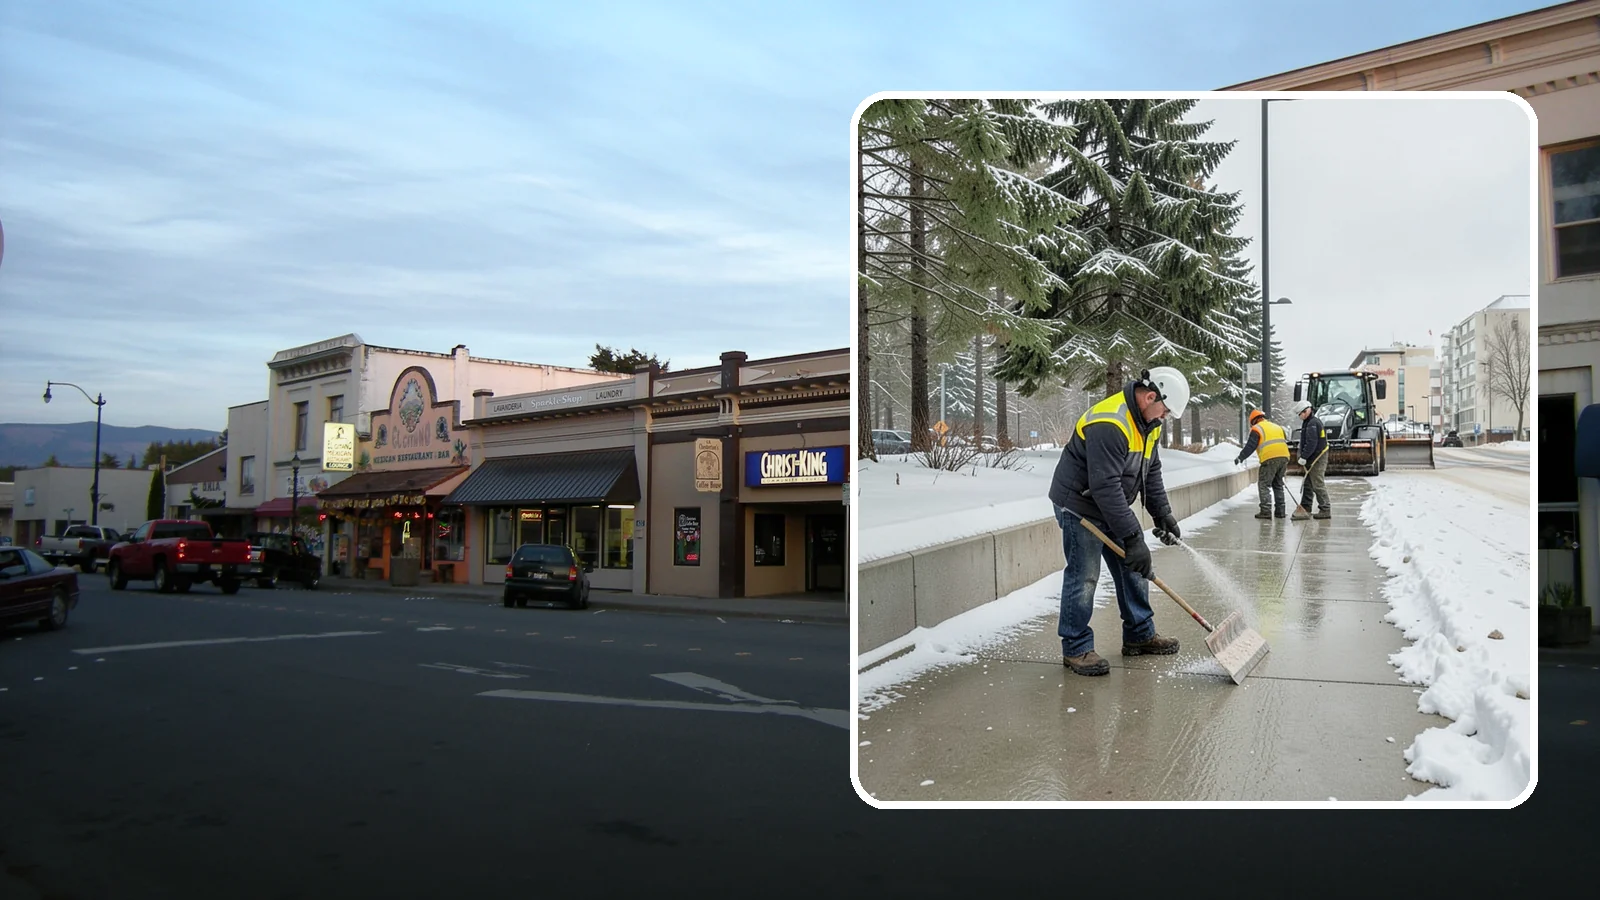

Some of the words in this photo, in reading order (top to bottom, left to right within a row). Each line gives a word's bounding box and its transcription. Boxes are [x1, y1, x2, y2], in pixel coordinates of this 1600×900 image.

[595, 388, 624, 400] LAUNDRY
[493, 402, 522, 413] LAVANDERIA
[531, 397, 561, 409] Sparkle
[562, 394, 583, 405] Shop
[373, 454, 396, 464] MEXICAN
[397, 451, 434, 462] RESTAURANT
[437, 450, 450, 459] BAR
[760, 451, 798, 478] CHRIST
[799, 450, 828, 477] KING
[696, 480, 709, 489] Coffee
